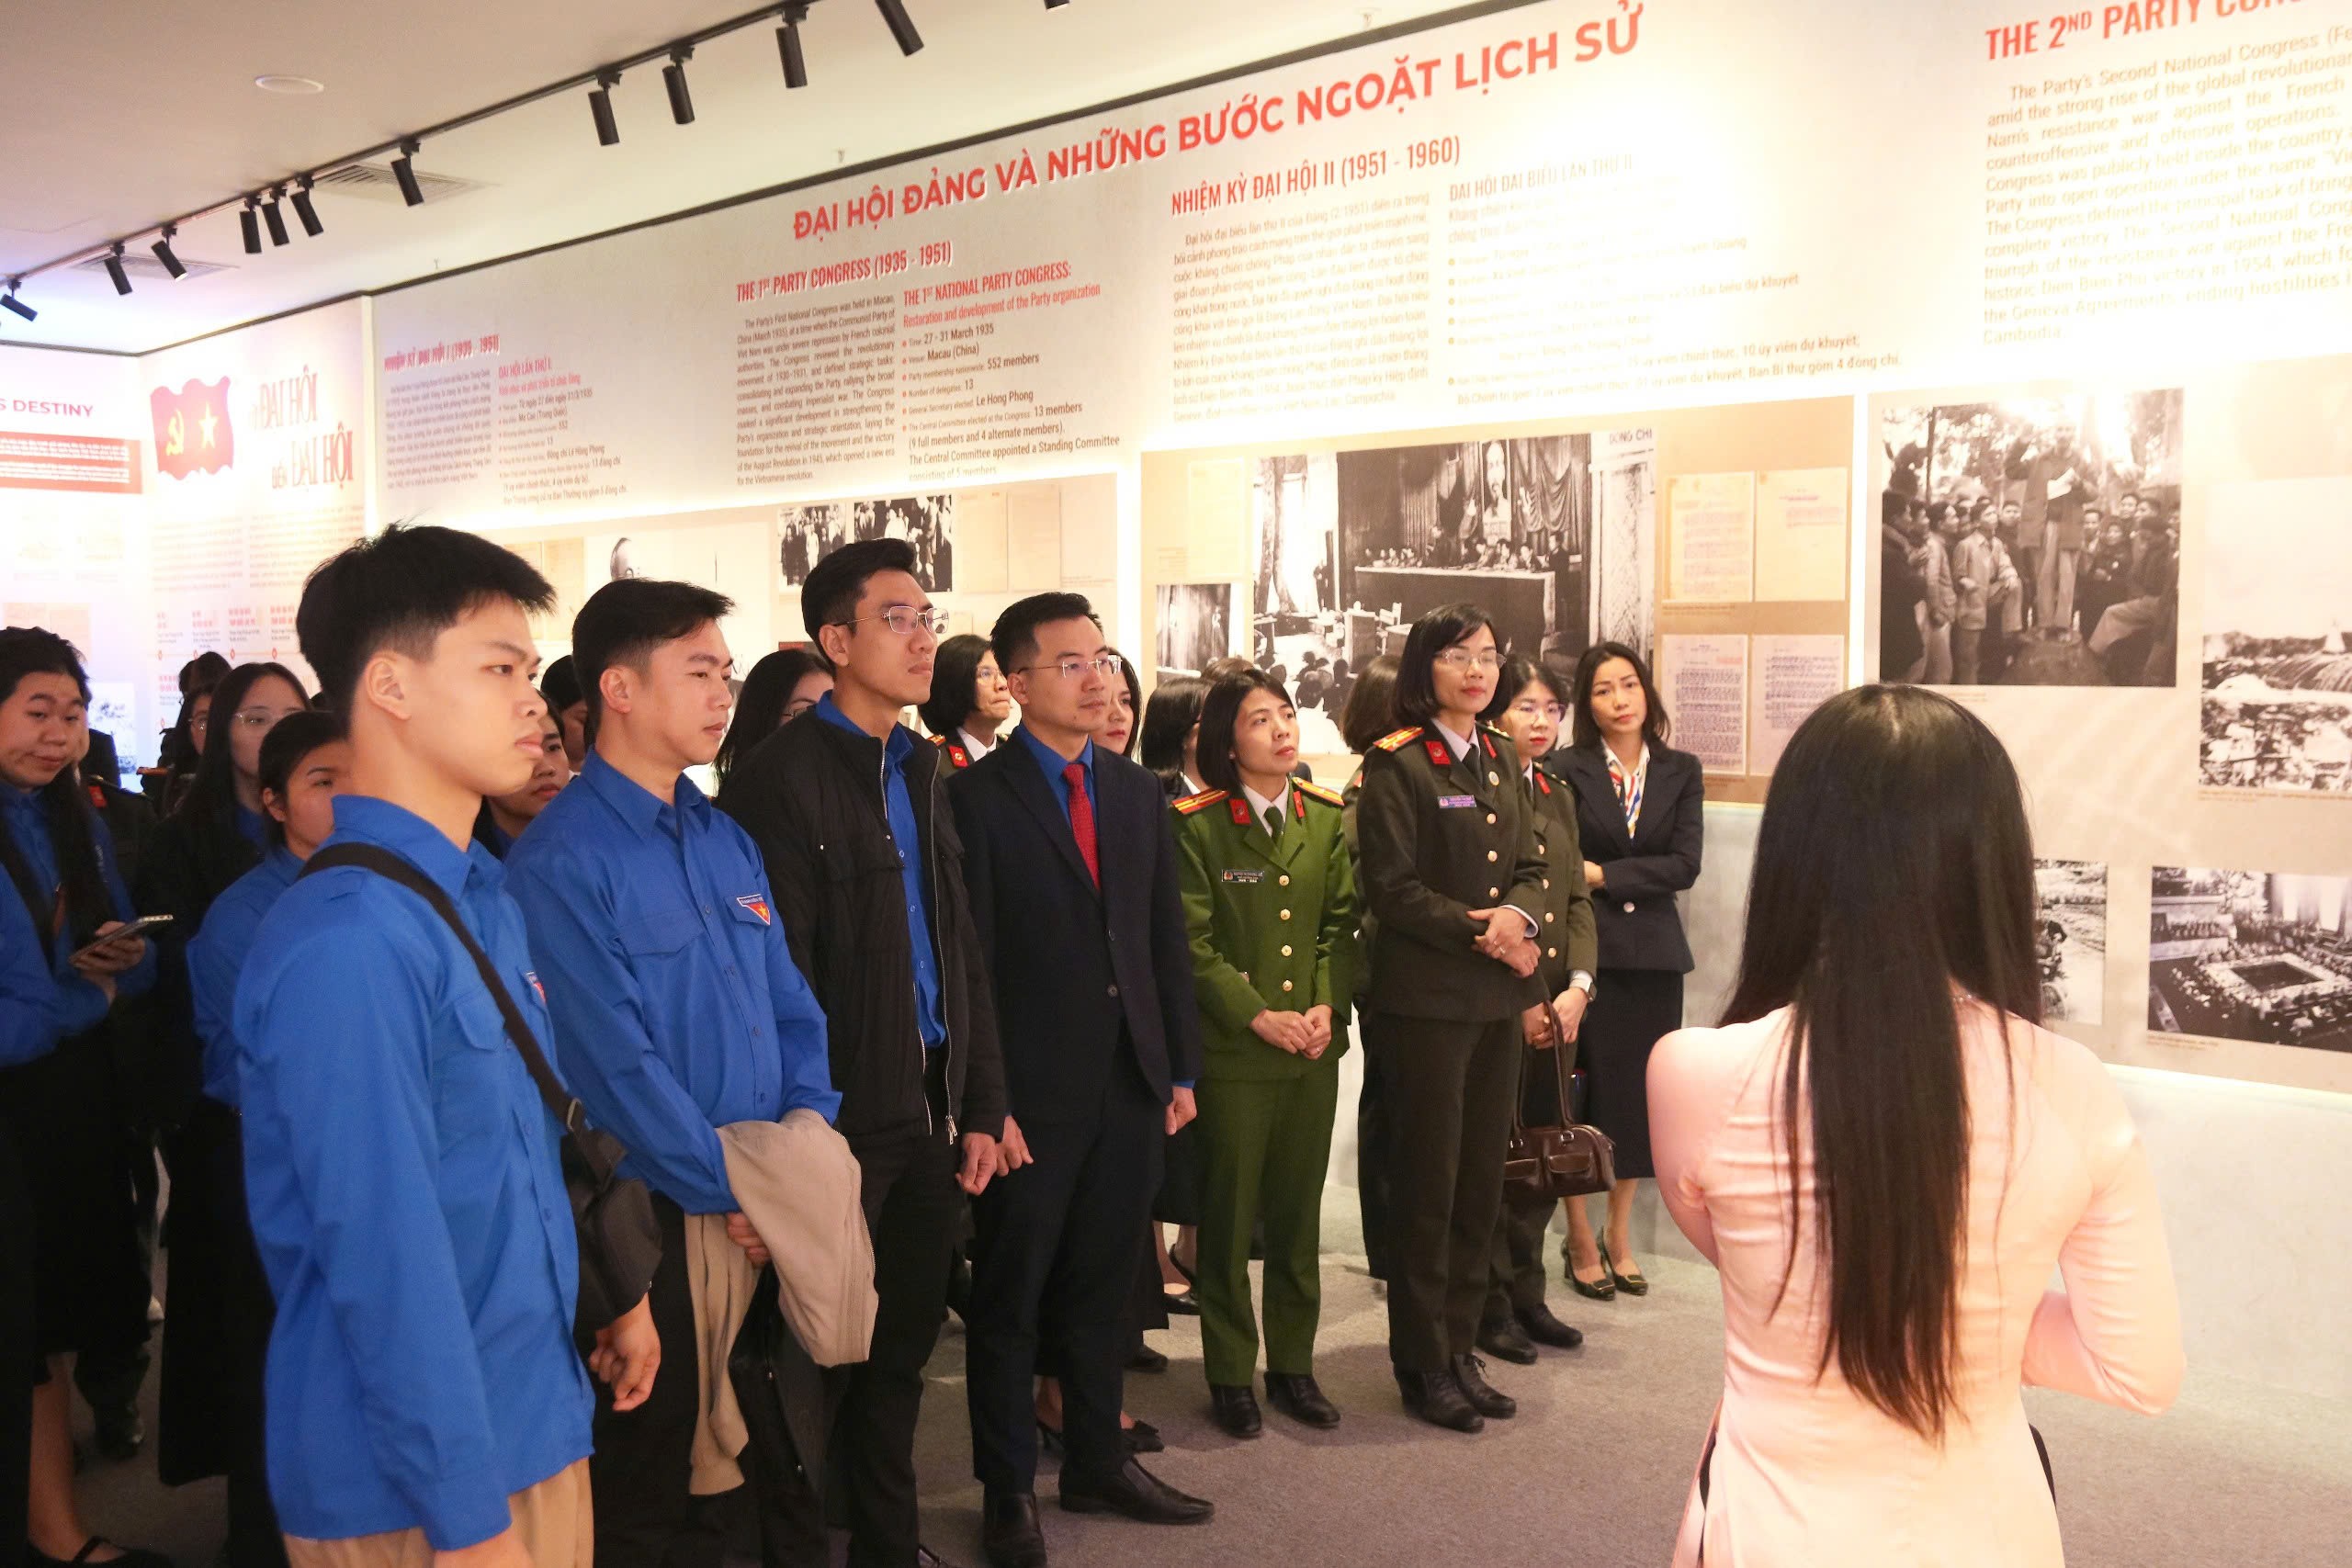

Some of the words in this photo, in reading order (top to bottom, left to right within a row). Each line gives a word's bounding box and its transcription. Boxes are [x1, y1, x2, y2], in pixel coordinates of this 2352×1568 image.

[1984, 20, 2039, 60] THE
[2049, 11, 2092, 49] 2ND
[2102, 0, 2203, 39] PARTY
[2099, 61, 2158, 85] Second
[2165, 46, 2232, 74] National
[2239, 35, 2319, 62] Congress
[1986, 107, 2022, 127] amid
[2028, 105, 2051, 119] the
[2057, 96, 2105, 115] strong
[2143, 83, 2160, 102] of
[2165, 81, 2190, 96] the
[2196, 68, 2246, 96] global
[2041, 117, 2119, 139] resistance
[2132, 111, 2160, 126] war
[2173, 96, 2232, 120] against
[2245, 91, 2271, 107] the
[2287, 75, 2345, 100] French
[793, 197, 837, 243] ĐẠI
[846, 185, 894, 231] HỘI
[902, 168, 987, 214] ĐẢNG
[995, 149, 1038, 193] VÀ
[1047, 125, 1166, 182] NHỮNG
[1178, 94, 1284, 152] BƯỚC
[1296, 56, 1442, 125] NGOẶT
[1455, 31, 1558, 96] LỊCH
[1575, 0, 1644, 62] SỬ
[2120, 131, 2149, 151] and
[1171, 179, 1222, 216] NHIỆM
[1227, 172, 1248, 205] KỲ
[1253, 172, 1281, 203] ĐẠI
[1287, 159, 1317, 197] HỘI
[1324, 161, 1334, 186] II
[1341, 150, 1386, 187] (1951
[1407, 135, 1460, 170] 1960)
[1985, 172, 2053, 192] Congress
[737, 281, 756, 302] THE
[773, 271, 808, 295] PARTY
[810, 257, 872, 288] CONGRESS
[875, 249, 908, 278] (1935
[919, 240, 953, 267] 1951)
[904, 288, 920, 306] THE
[935, 278, 978, 300] NATIONAL
[982, 272, 1012, 292] PARTY
[1015, 260, 1071, 287] CONGRESS:
[944, 309, 956, 321] and
[959, 299, 1004, 320] development
[1007, 297, 1014, 310] of
[1016, 296, 1028, 310] the
[1031, 292, 1050, 307] Party
[1053, 284, 1101, 305] organization
[924, 333, 933, 344] 27
[940, 331, 948, 343] 31
[951, 327, 973, 340] March
[976, 323, 994, 335] 1935
[928, 350, 951, 361] Macau
[953, 343, 979, 359] (China)
[988, 356, 1001, 369] 552
[1003, 353, 1039, 367] members
[1837, 358, 1843, 369] 4
[965, 378, 974, 390] 13
[13, 400, 94, 417] DESTINY
[977, 396, 986, 407] Le
[987, 394, 1007, 406] Hong
[1009, 390, 1034, 403] Phong
[1035, 405, 1044, 417] 13
[1046, 402, 1082, 416] members
[910, 454, 922, 465] The
[924, 453, 949, 464] Central
[951, 448, 991, 461] Committee
[993, 444, 1029, 460] appointed
[1038, 439, 1073, 454] Standing
[1075, 434, 1120, 449] Committee
[918, 436, 930, 446] full
[931, 434, 964, 446] members
[966, 432, 978, 442] and
[981, 430, 986, 440] 4
[988, 427, 1022, 440] alternate
[322, 421, 354, 490] HỘI
